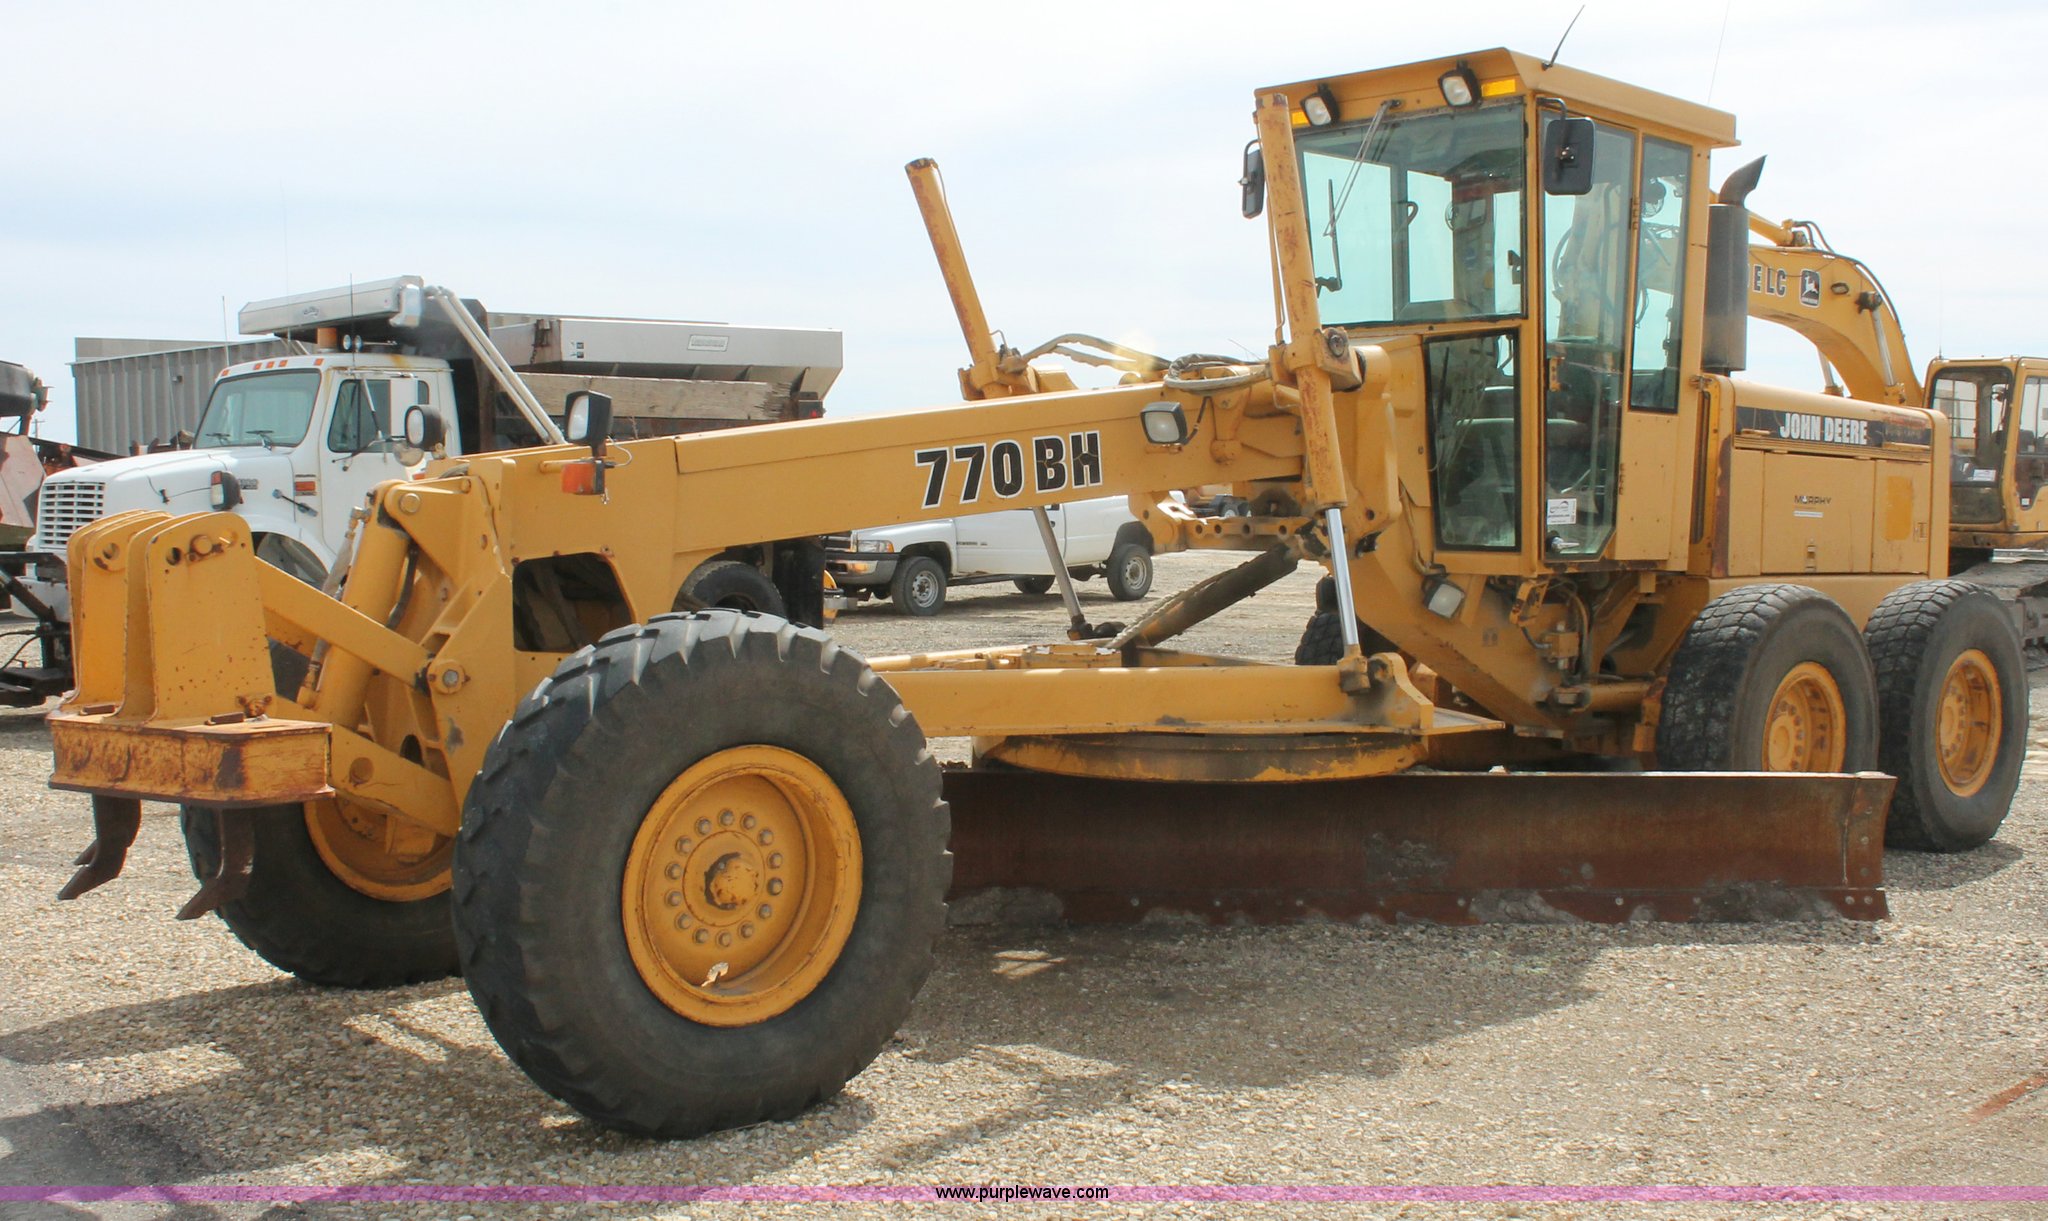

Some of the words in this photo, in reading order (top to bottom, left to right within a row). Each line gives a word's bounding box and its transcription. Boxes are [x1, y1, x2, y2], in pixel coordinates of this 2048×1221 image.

[1780, 412, 1821, 441] JOHN
[1824, 416, 1868, 445] DEERE
[914, 439, 1025, 509] 770
[1032, 430, 1103, 494] BH
